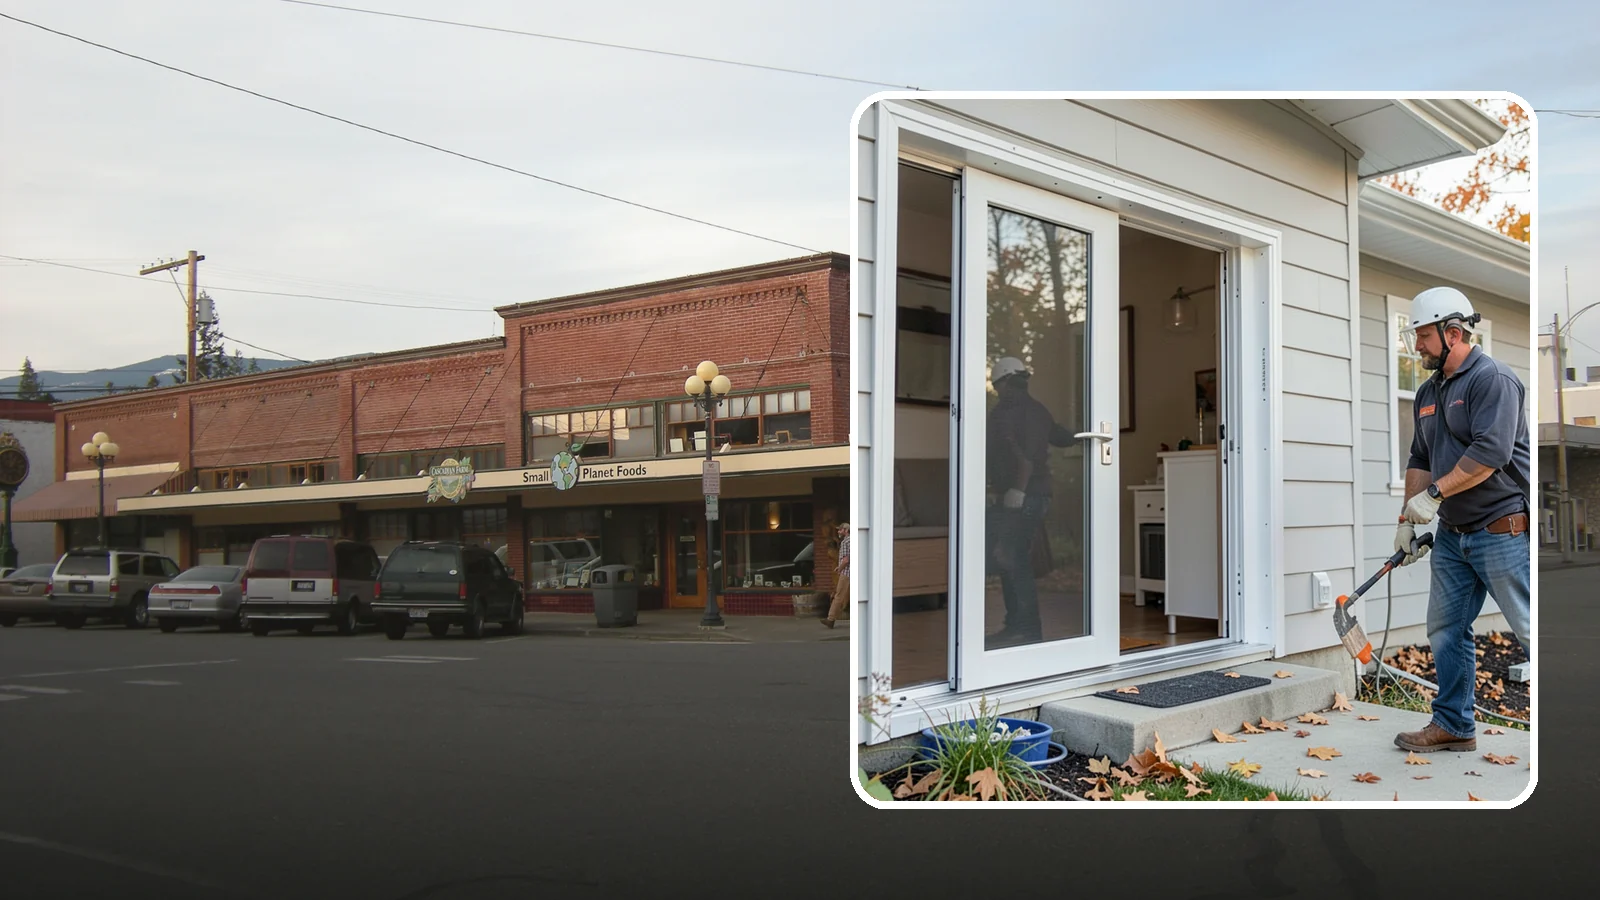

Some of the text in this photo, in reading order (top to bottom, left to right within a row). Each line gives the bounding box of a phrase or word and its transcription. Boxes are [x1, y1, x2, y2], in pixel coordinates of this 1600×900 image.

[523, 464, 647, 483] Small Planet Foods
